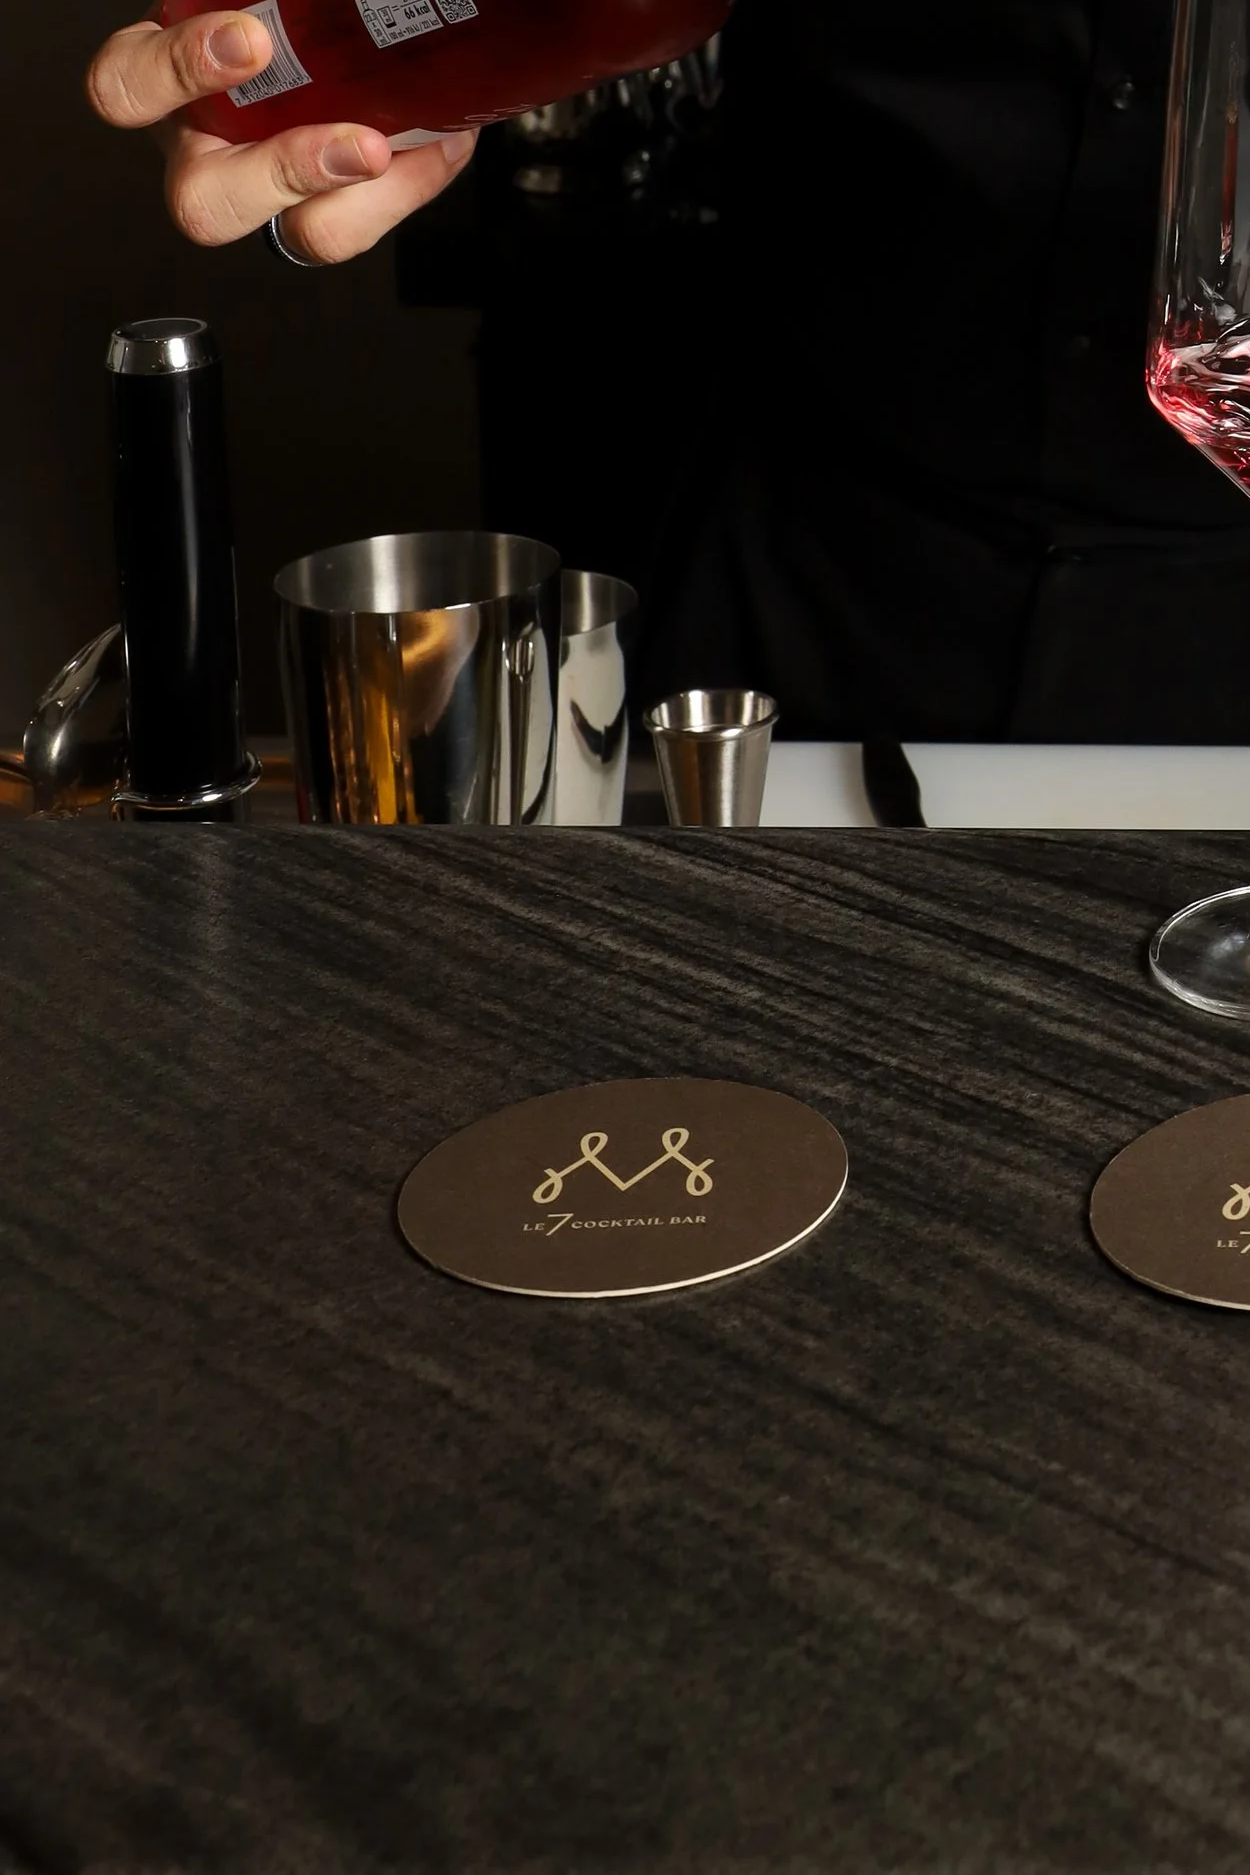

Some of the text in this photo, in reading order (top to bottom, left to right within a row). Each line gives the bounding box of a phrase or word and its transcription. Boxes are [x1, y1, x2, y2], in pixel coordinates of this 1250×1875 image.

[404, 8, 416, 20] 66
[522, 1213, 707, 1236] LE 7 COCKTAIL BAR
[1216, 1239, 1239, 1248] LE
